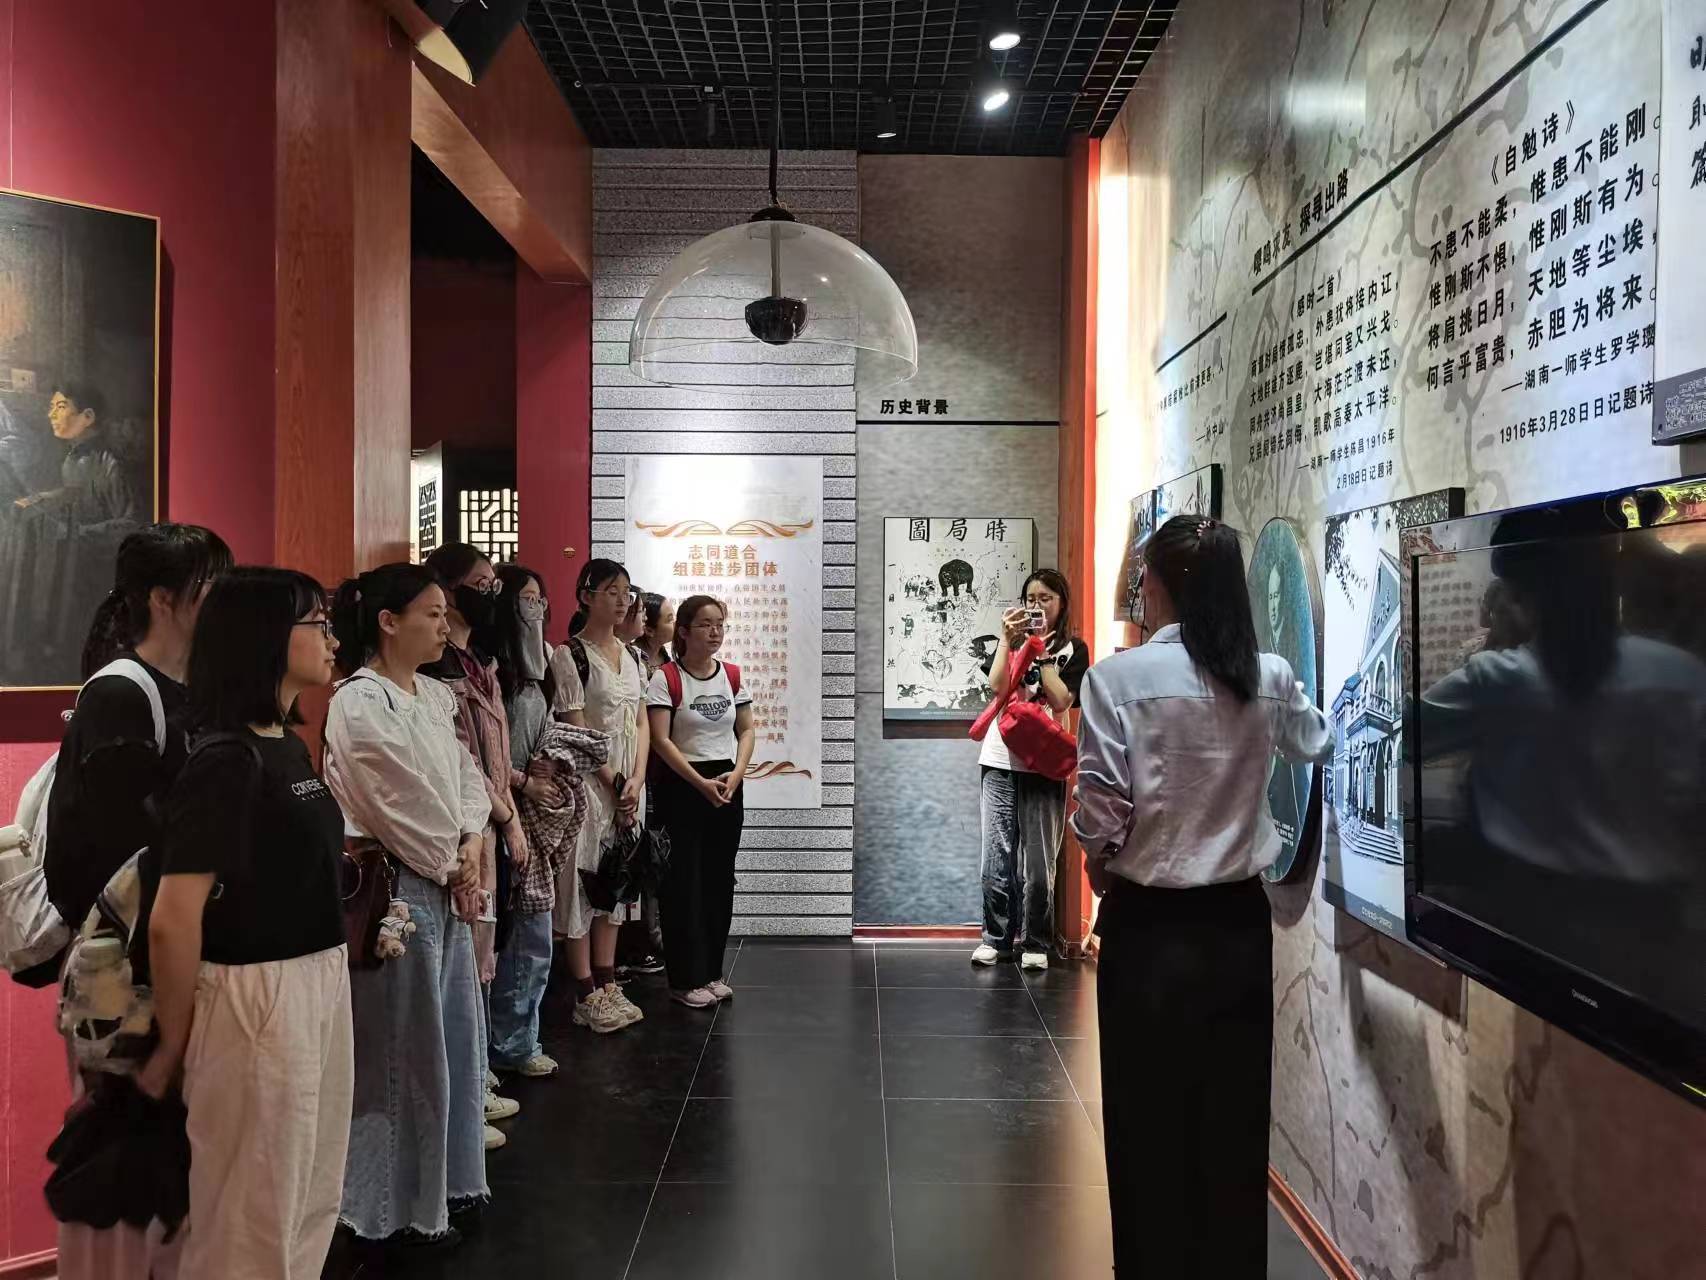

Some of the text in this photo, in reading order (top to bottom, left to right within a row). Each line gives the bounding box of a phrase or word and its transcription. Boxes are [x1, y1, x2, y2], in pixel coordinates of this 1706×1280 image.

[1491, 99, 1575, 186] 《自勉诗》
[1300, 168, 1348, 236] 探寻出路
[880, 398, 949, 414] 历史背景
[1500, 379, 1654, 444] 1916年3月28日日记题诗
[673, 561, 778, 577] 组建进步团体
[688, 544, 758, 560] 志同道合
